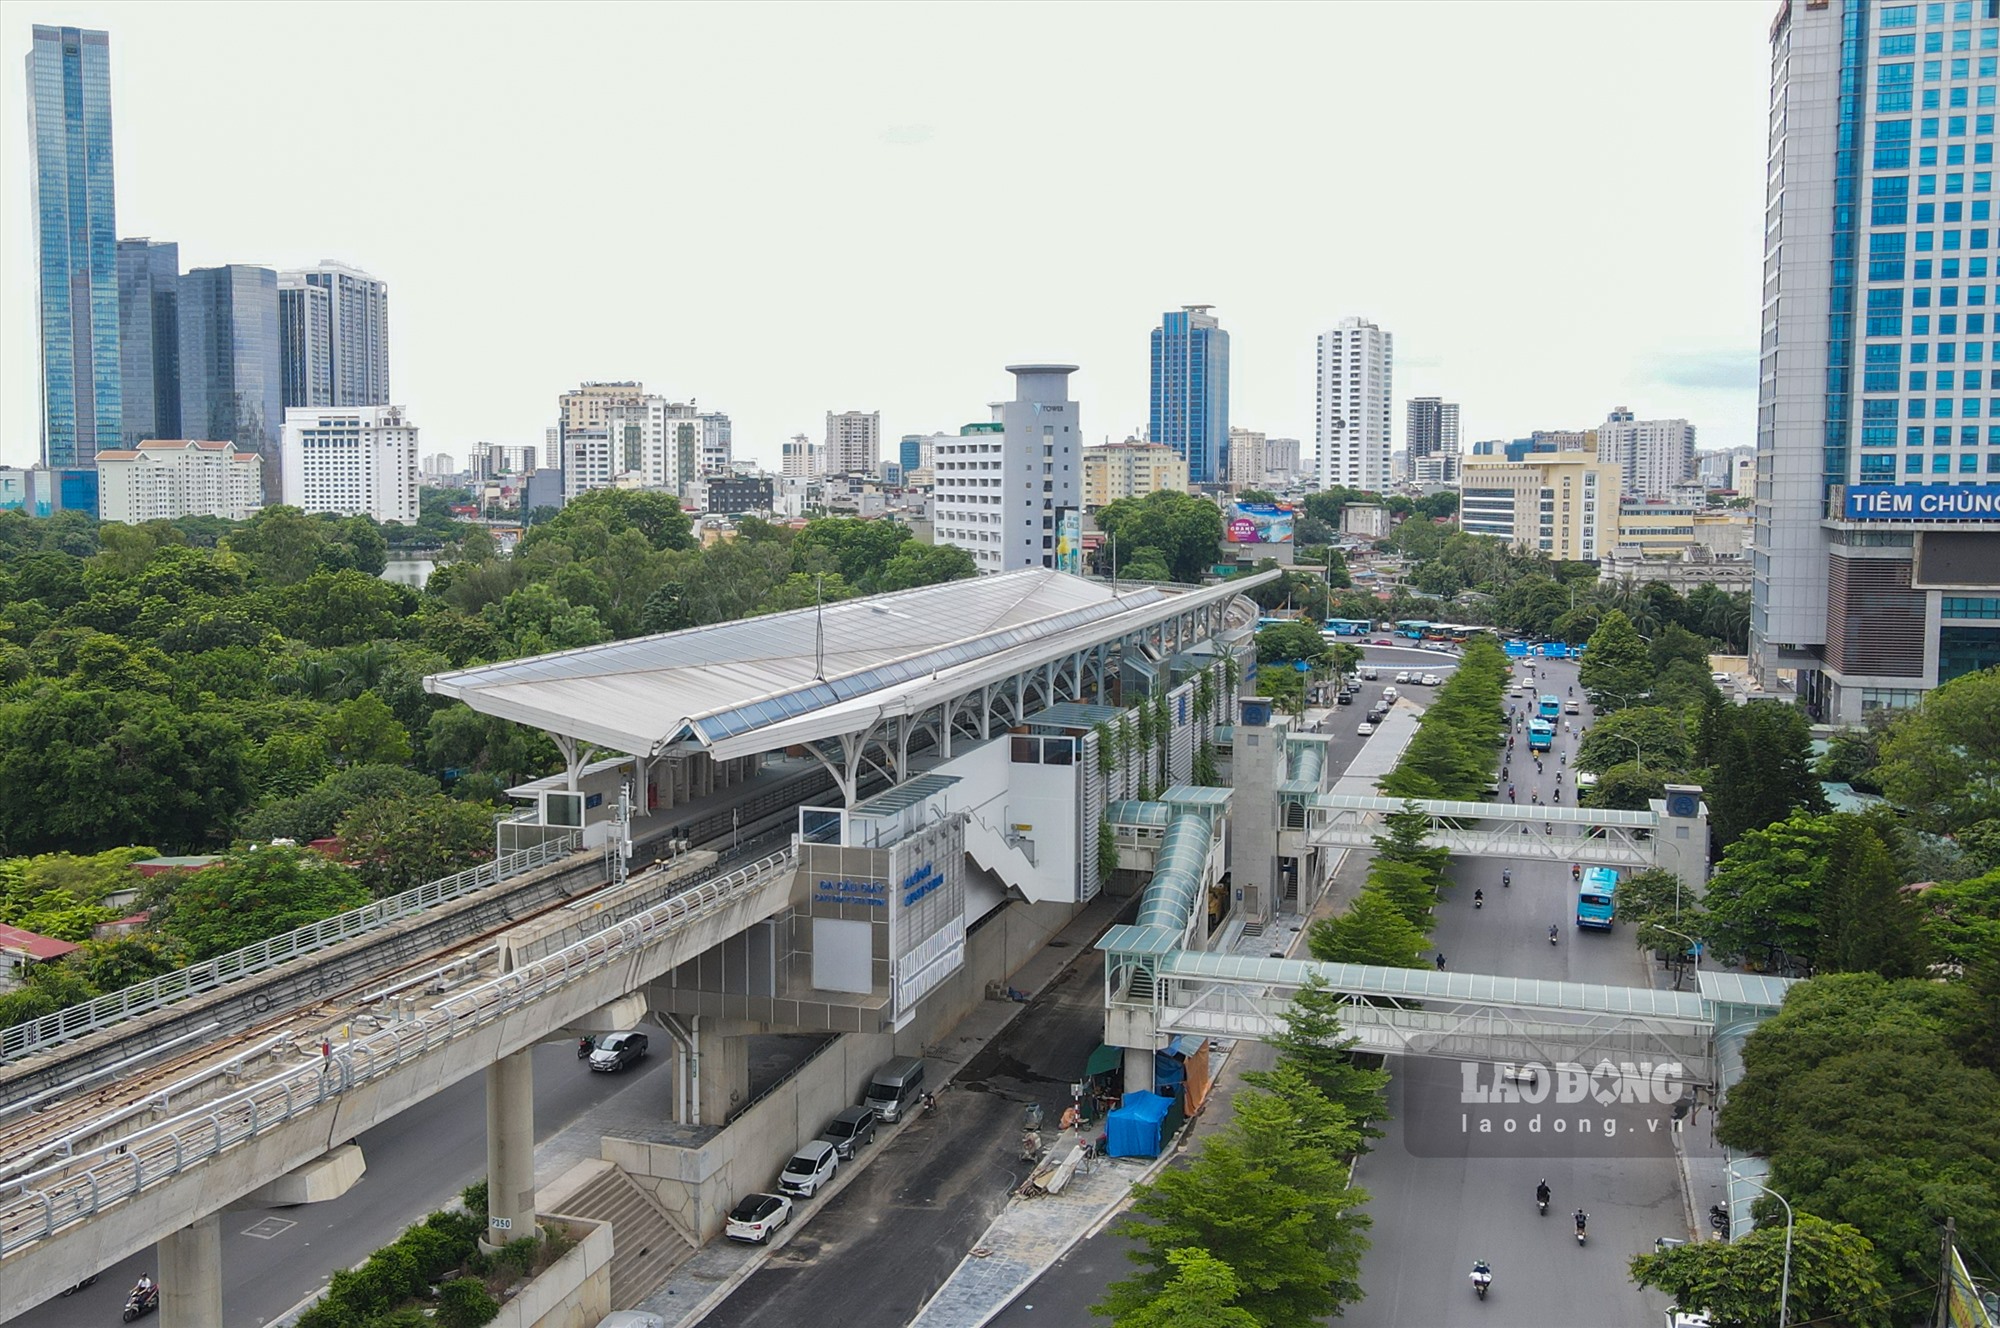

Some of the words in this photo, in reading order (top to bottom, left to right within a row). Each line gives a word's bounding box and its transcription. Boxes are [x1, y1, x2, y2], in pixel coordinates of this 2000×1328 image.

[1852, 490, 1912, 512] TIÊM
[820, 879, 834, 890] GA
[492, 1218, 510, 1228] P350
